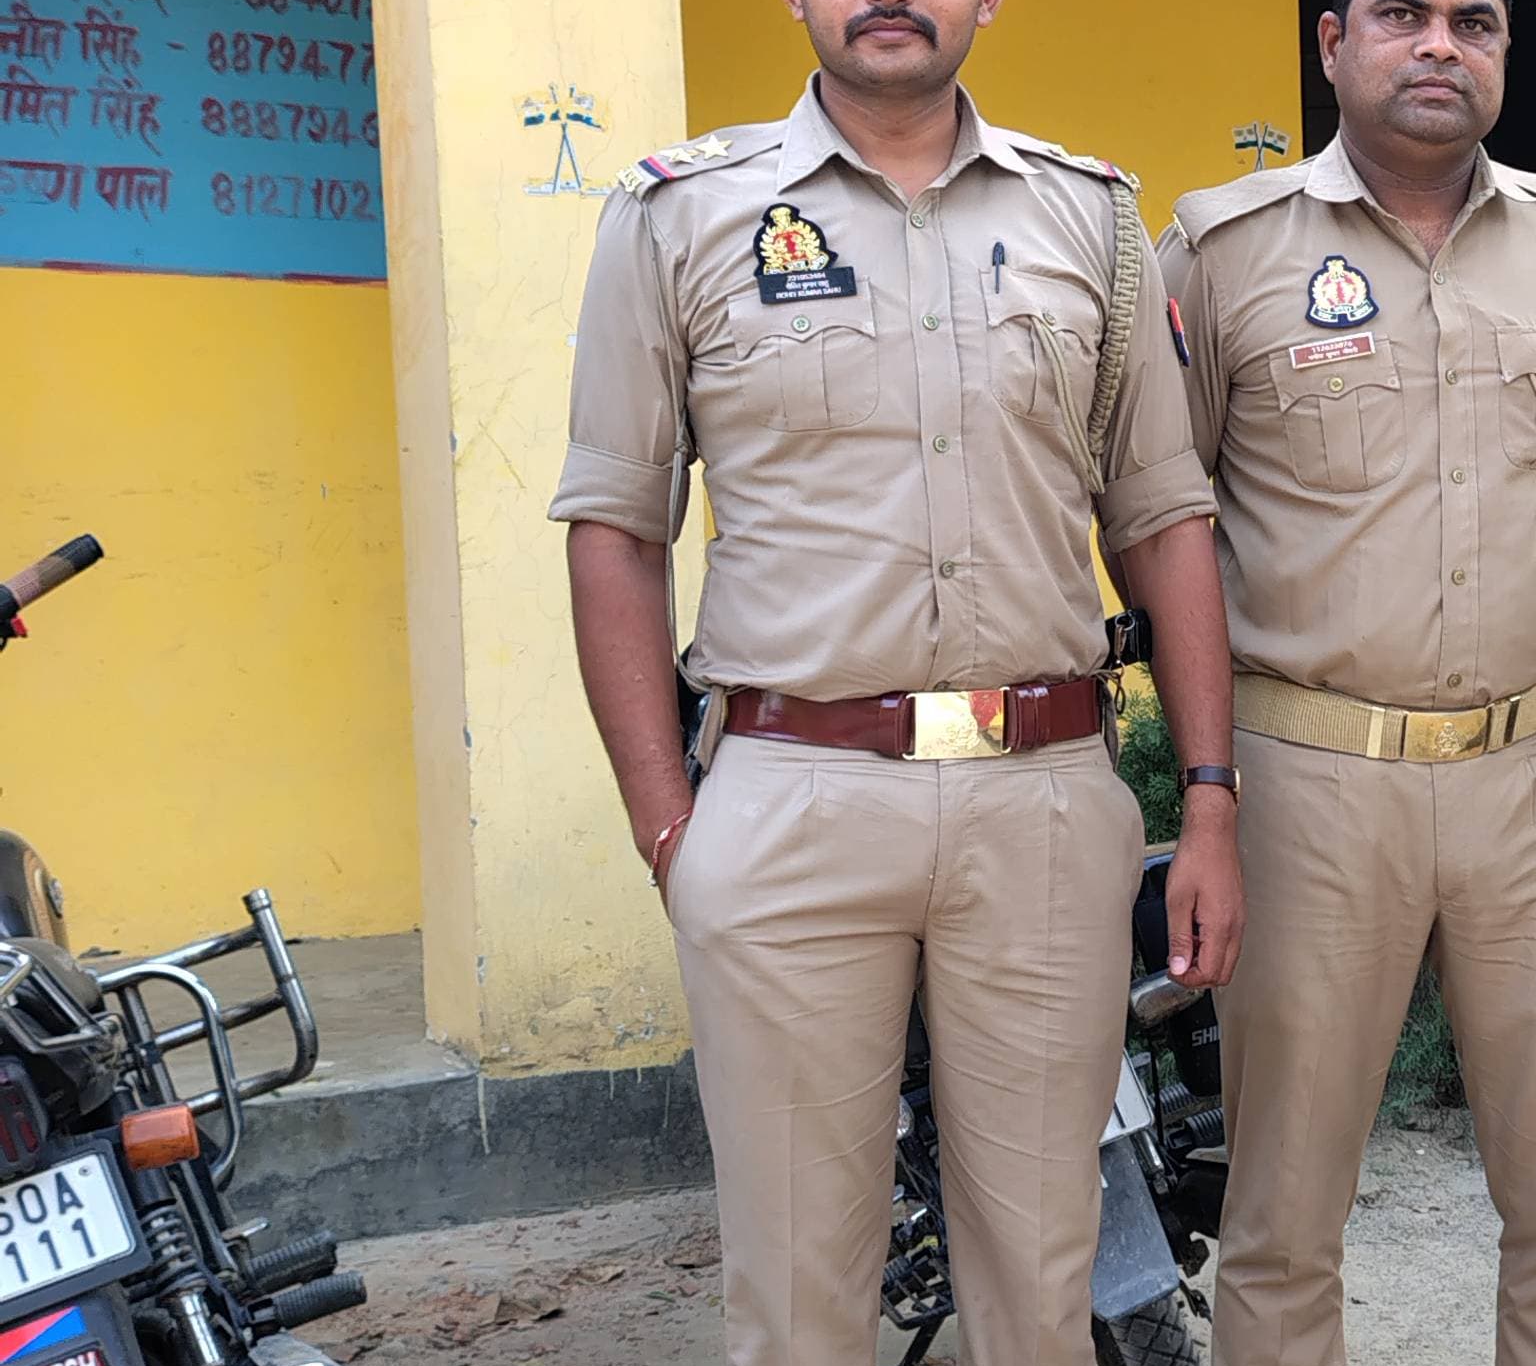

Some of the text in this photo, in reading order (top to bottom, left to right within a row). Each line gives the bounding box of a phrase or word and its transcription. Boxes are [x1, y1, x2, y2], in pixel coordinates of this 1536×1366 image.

[95, 164, 172, 225] पाल
[211, 171, 384, 222] 8127102
[5, 1217, 96, 1282] 111
